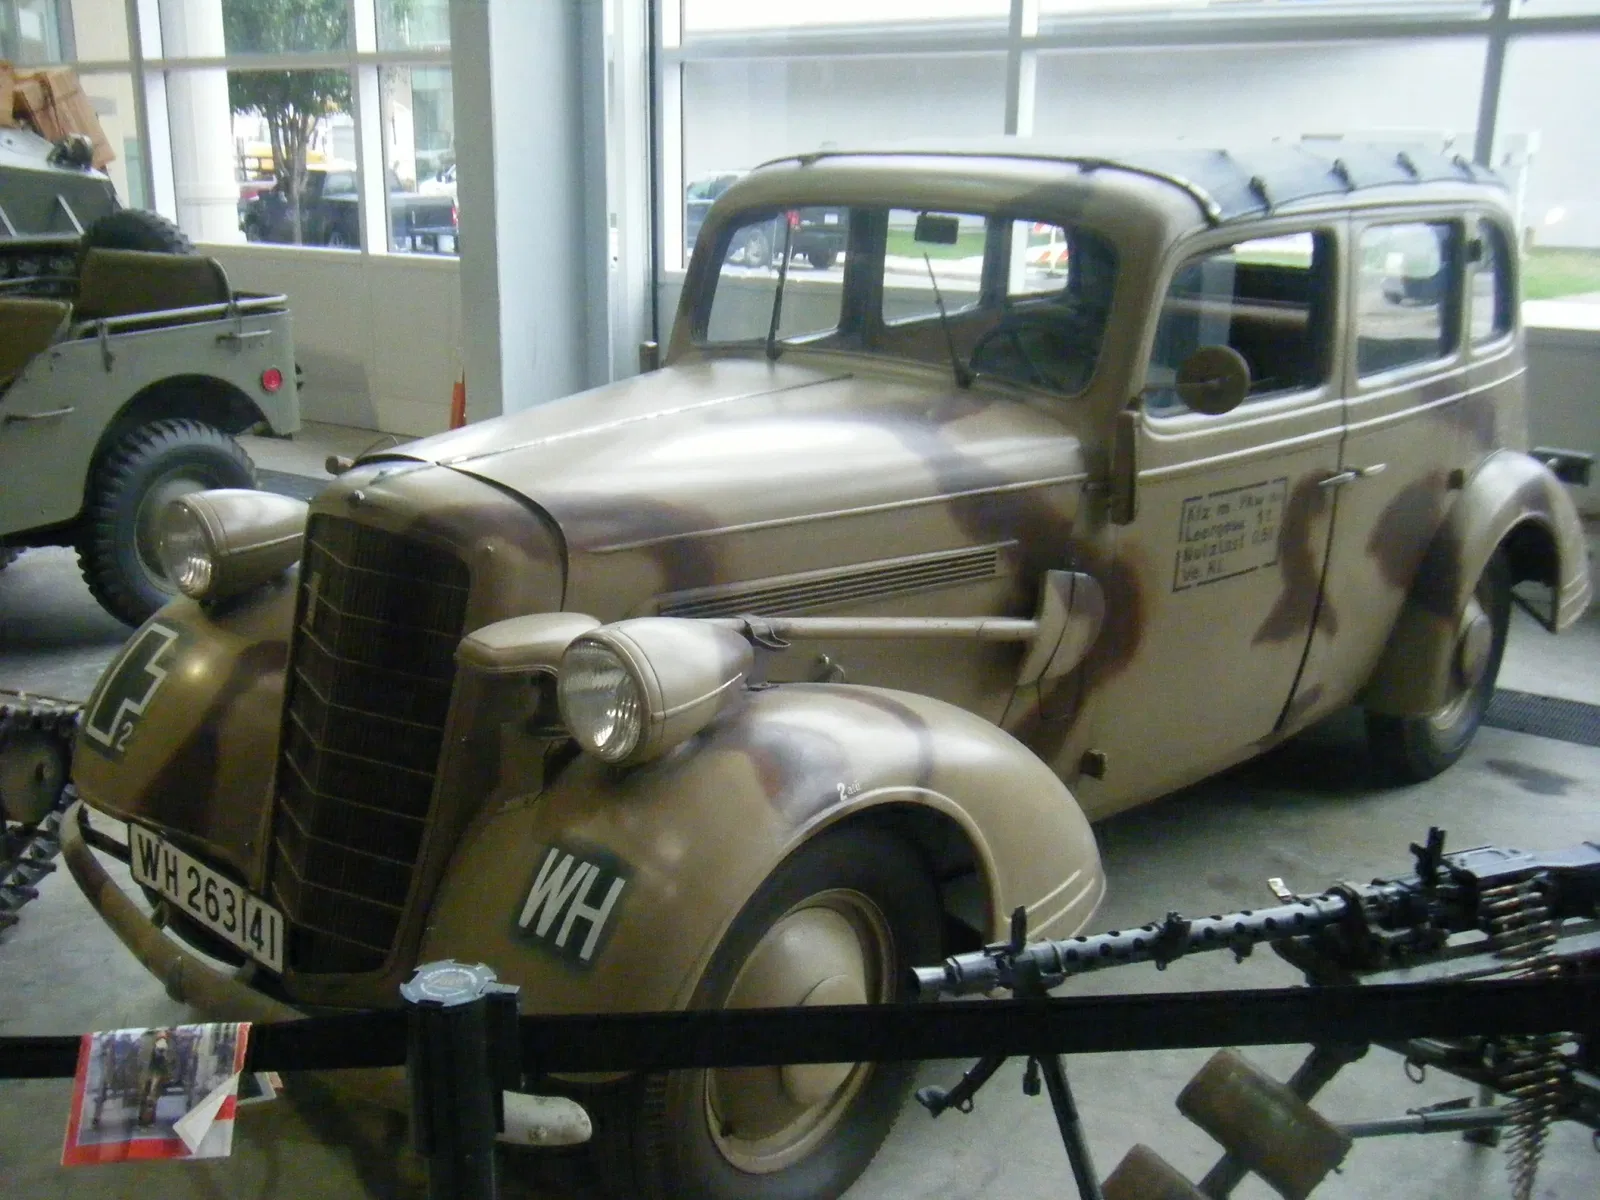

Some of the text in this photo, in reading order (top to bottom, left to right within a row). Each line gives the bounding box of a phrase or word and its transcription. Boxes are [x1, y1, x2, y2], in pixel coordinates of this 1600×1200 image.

[116, 721, 133, 752] 2
[836, 782, 848, 801] 2
[137, 833, 178, 897] WH
[518, 847, 626, 961] WH
